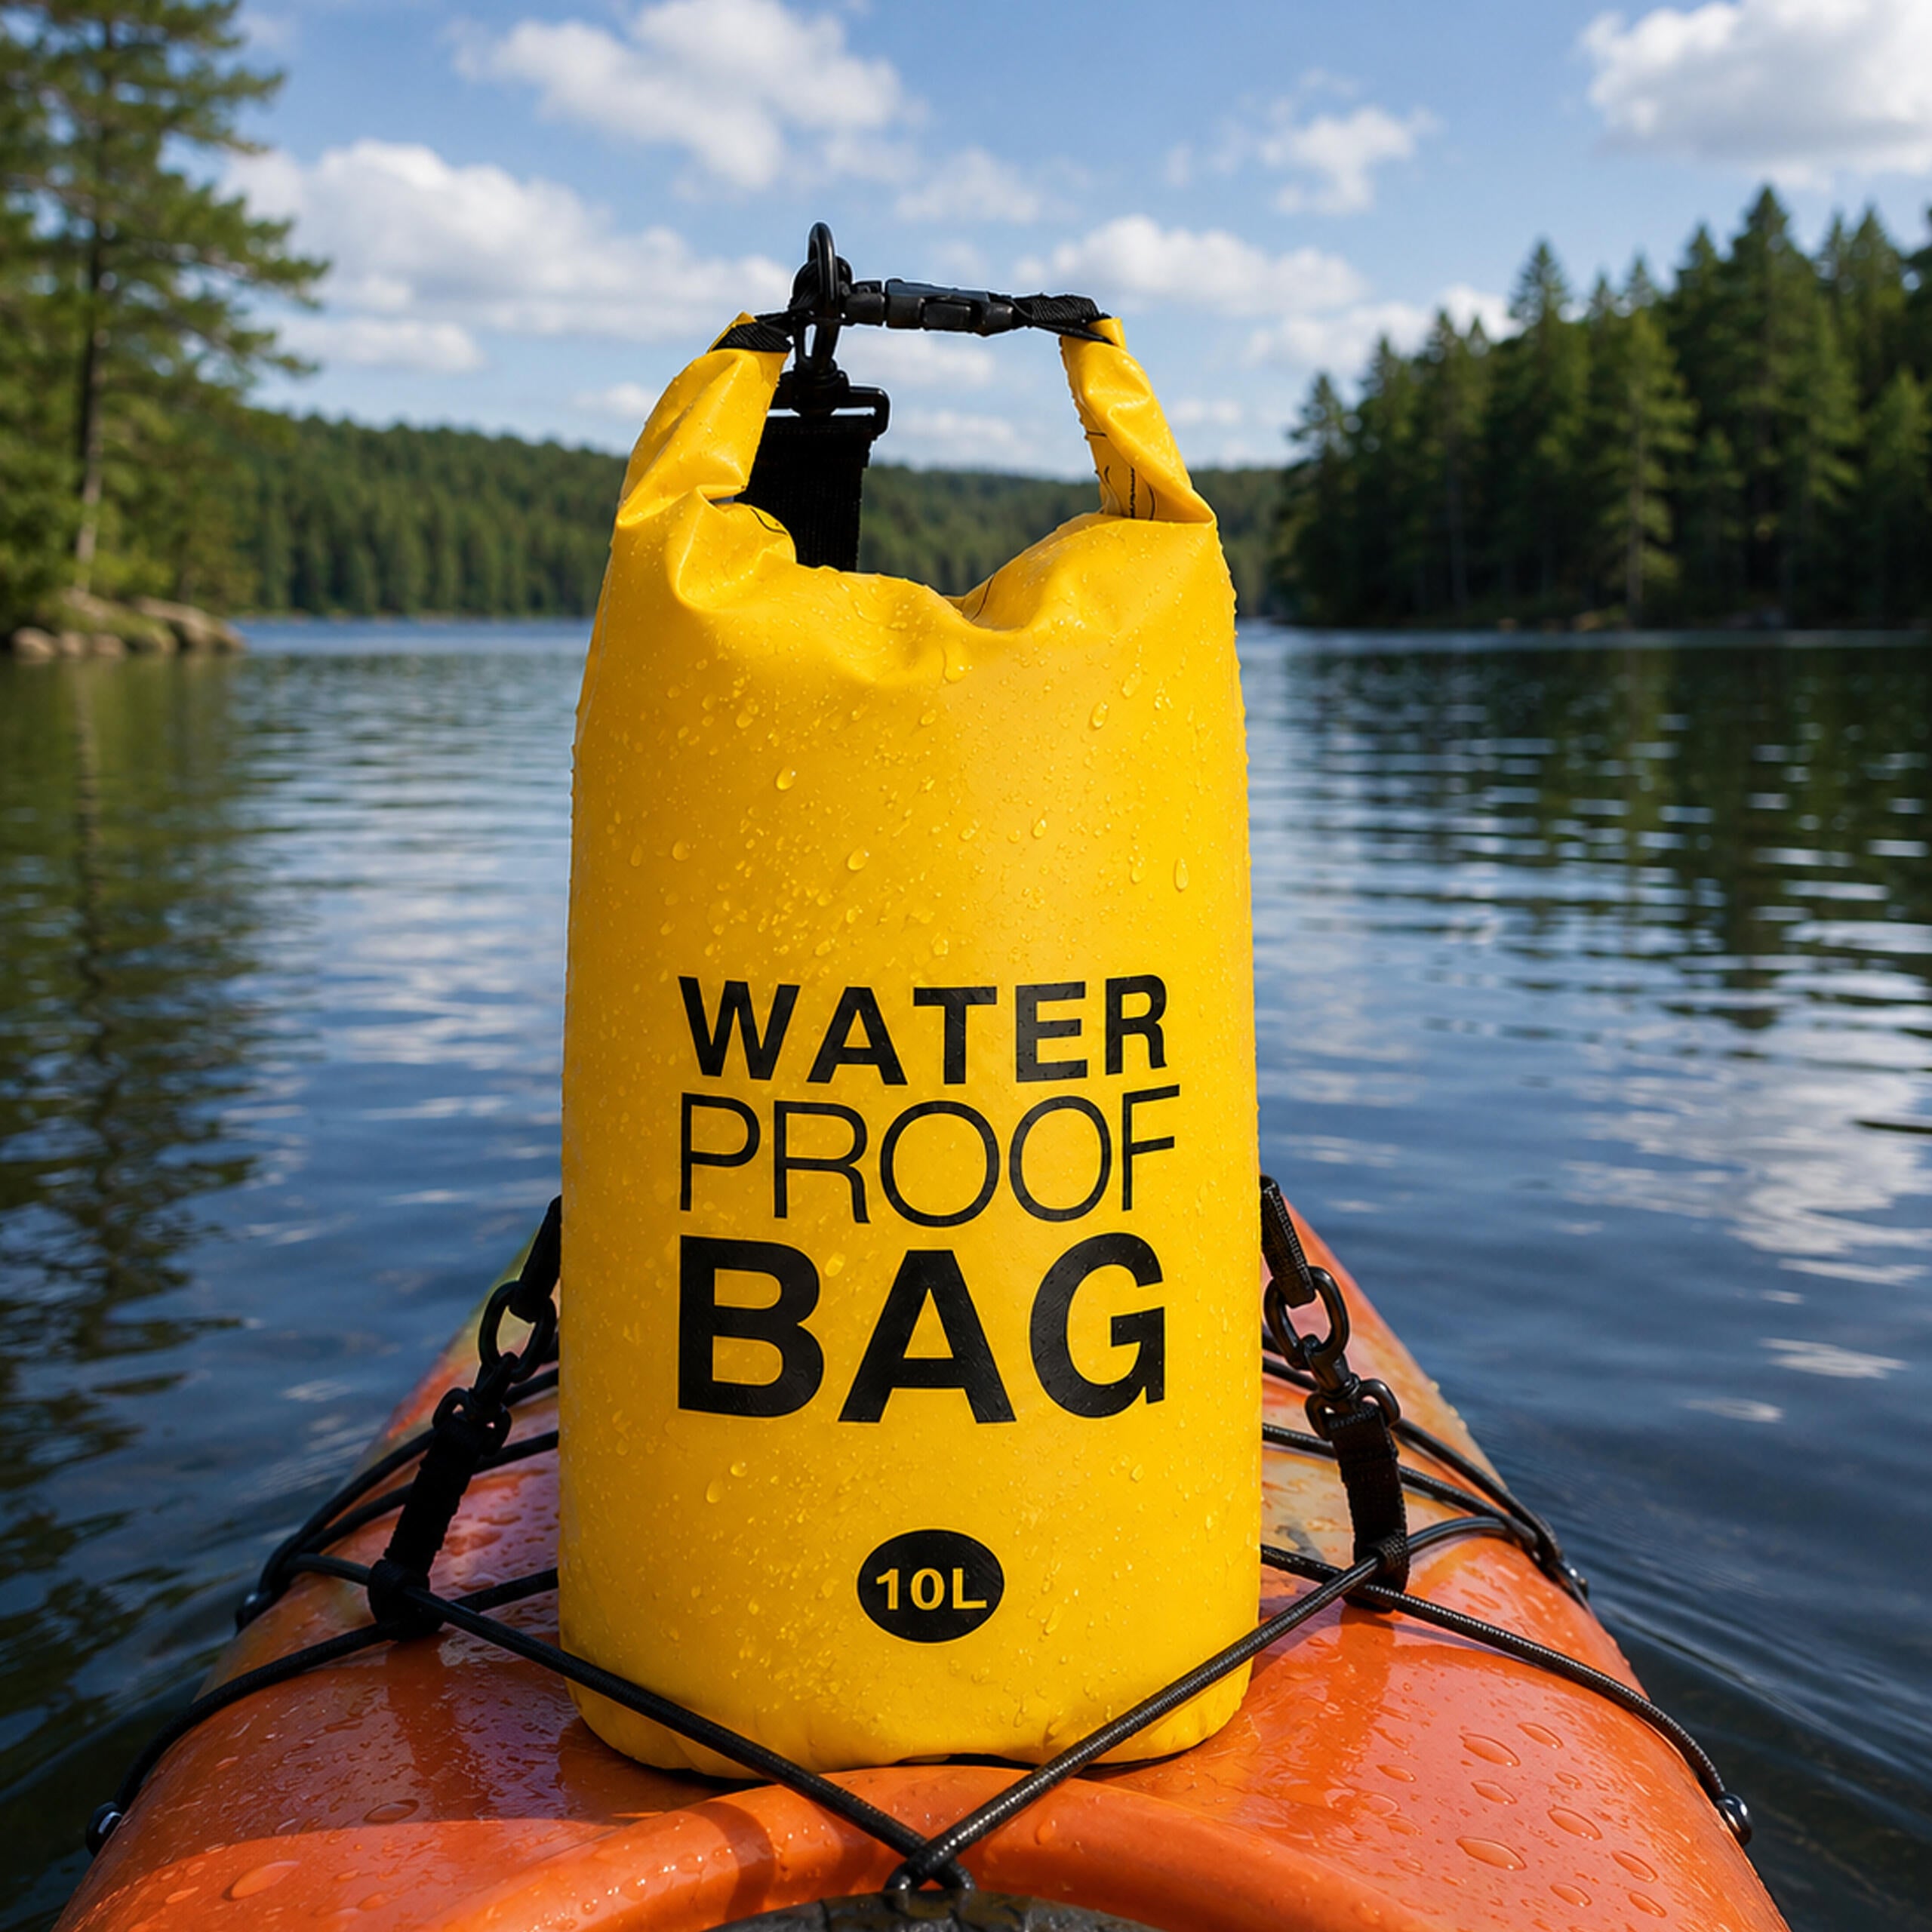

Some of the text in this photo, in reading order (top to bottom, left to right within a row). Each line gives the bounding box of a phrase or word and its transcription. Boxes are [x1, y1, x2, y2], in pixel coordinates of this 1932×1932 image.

[678, 974, 1168, 1086] WATER
[679, 1084, 1181, 1228] PROOF
[678, 1233, 1166, 1425] BAG
[876, 1567, 988, 1611] 10L
